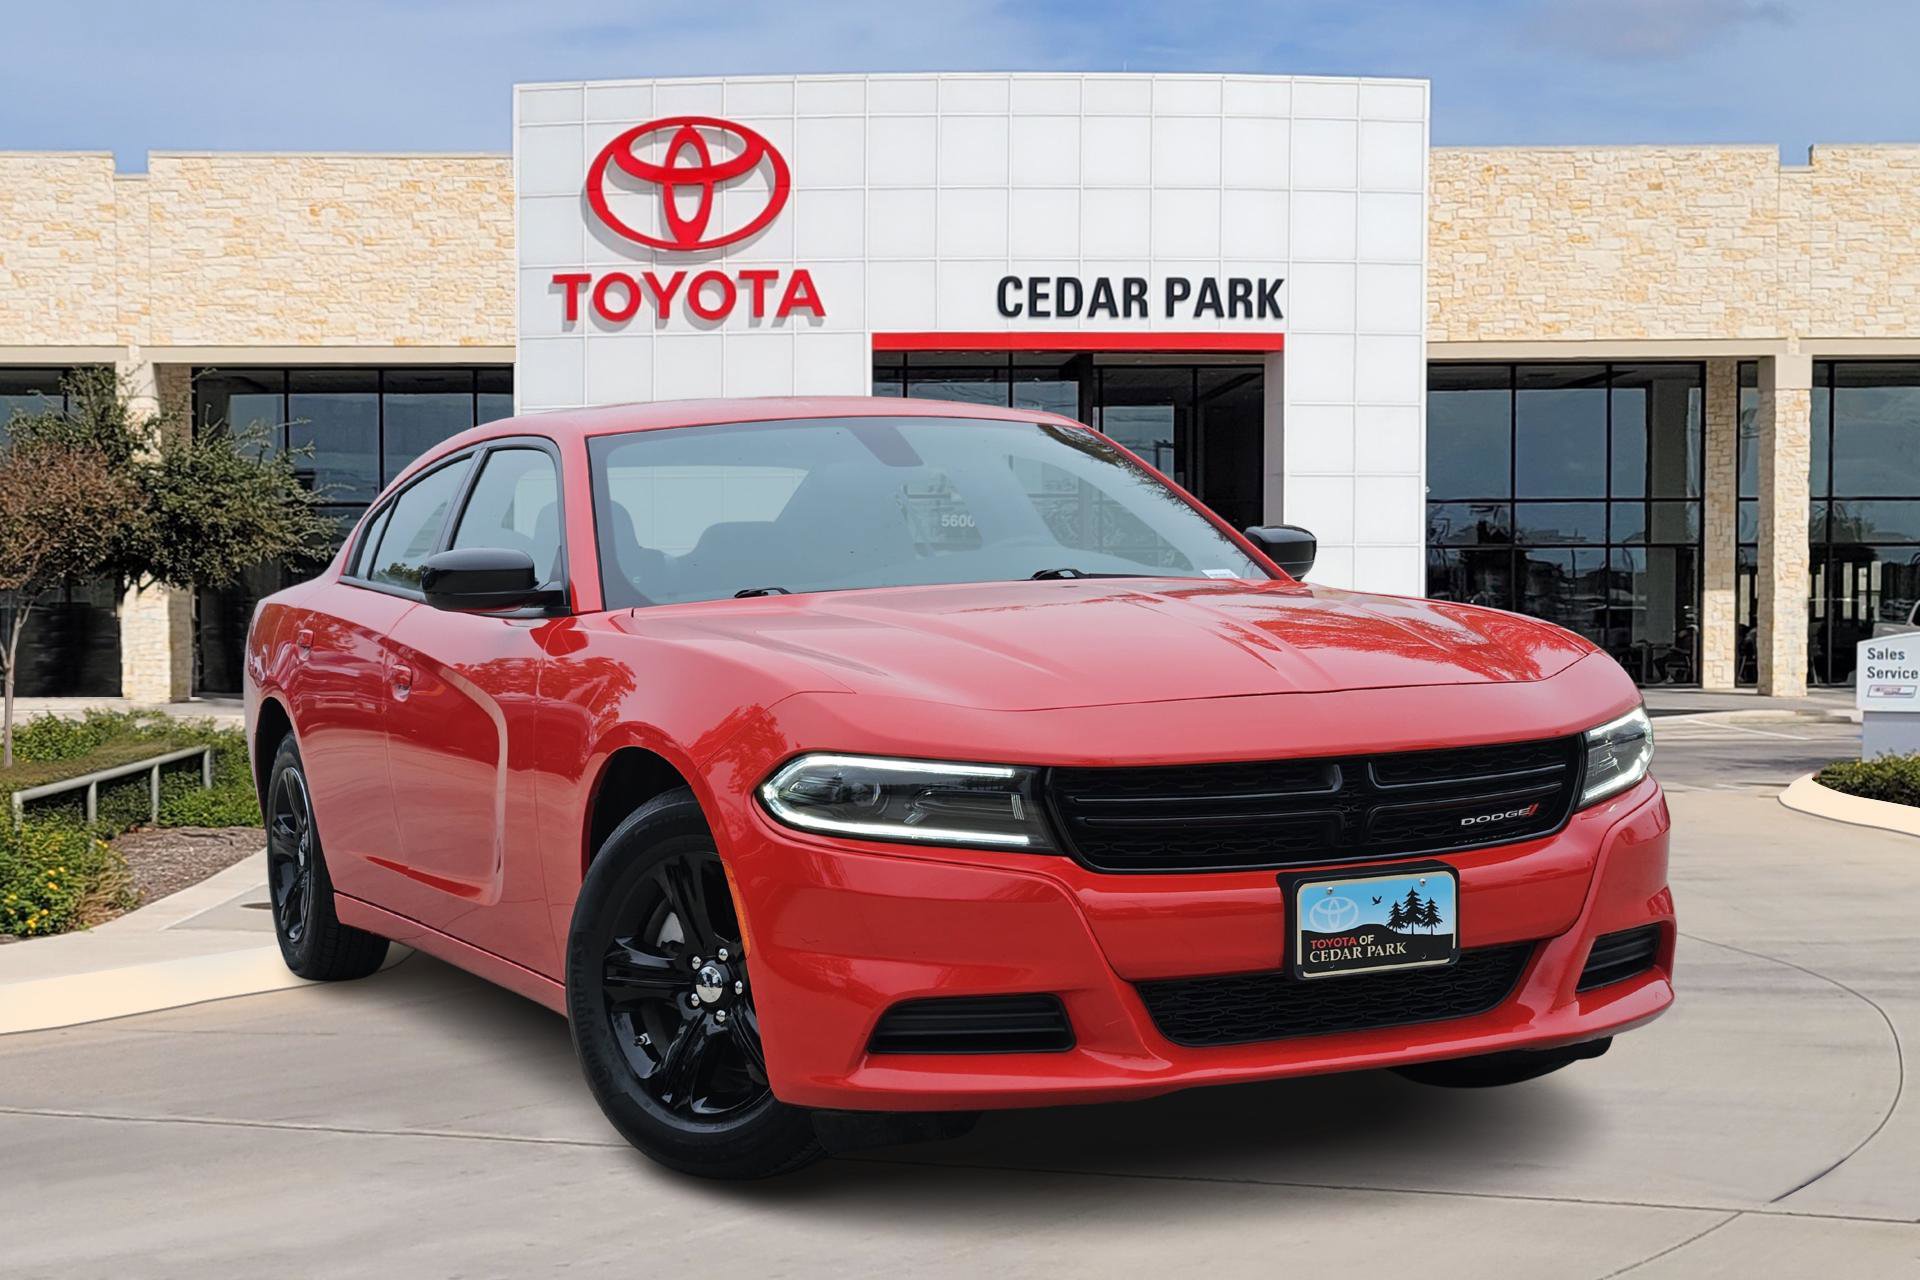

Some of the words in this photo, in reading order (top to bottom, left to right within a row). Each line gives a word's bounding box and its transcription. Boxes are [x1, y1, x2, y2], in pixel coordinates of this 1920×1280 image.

[552, 269, 827, 323] TOYOTA
[996, 275, 1149, 319] CEDAR
[1165, 277, 1286, 319] PARK
[1867, 647, 1905, 660] Sales
[1867, 666, 1919, 680] Service
[1461, 807, 1531, 825] DODGE
[1310, 936, 1357, 950] TOYOTA
[1359, 934, 1375, 945] OF
[1309, 945, 1363, 963] CEDAR
[1367, 942, 1407, 957] PARK
